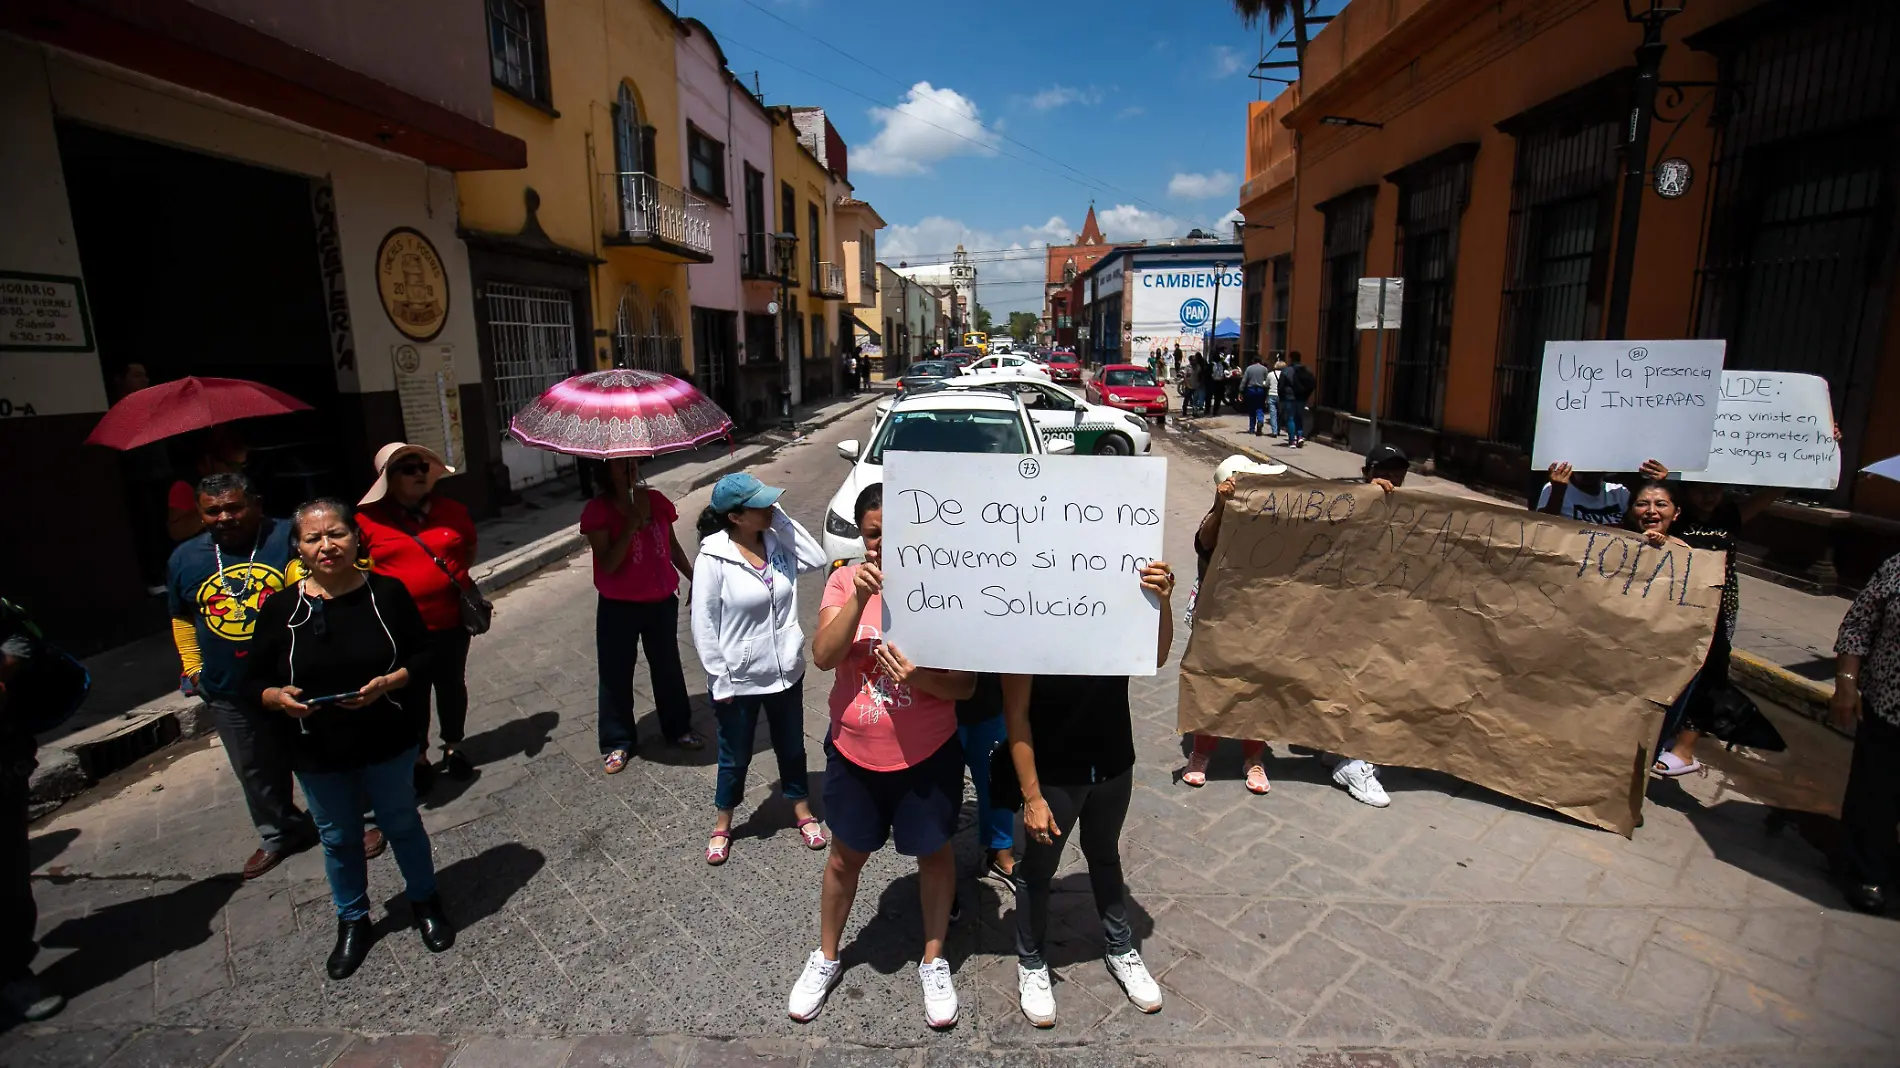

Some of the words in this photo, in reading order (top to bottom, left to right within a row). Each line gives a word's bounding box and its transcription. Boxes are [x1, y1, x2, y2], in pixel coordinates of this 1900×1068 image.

[314, 186, 353, 371] CAFETERIA
[1143, 273, 1241, 288] CAMBIEMOS
[393, 282, 404, 295] 20
[1184, 305, 1205, 320] PAN
[1632, 350, 1644, 358] 81
[1558, 354, 1604, 393] Urge
[1616, 359, 1632, 379] la
[1644, 366, 1712, 388] presencia
[1555, 390, 1587, 410] del
[1601, 391, 1706, 408] INTERAPAS
[1749, 412, 1792, 423] viniste
[1797, 414, 1817, 425] en
[1731, 430, 1740, 438] a
[1729, 448, 1771, 465] vengas
[1793, 449, 1835, 465] Cumplir
[1023, 462, 1037, 475] 73
[898, 489, 965, 526] De
[981, 495, 1048, 543] aqui
[1064, 502, 1104, 523] no
[1117, 503, 1160, 526] nos
[897, 543, 1017, 569] movemo
[1031, 549, 1056, 569] si
[1071, 552, 1107, 571] no
[1576, 528, 1707, 609] TOTAL
[906, 582, 964, 613] dan
[981, 585, 1107, 617] Solución
